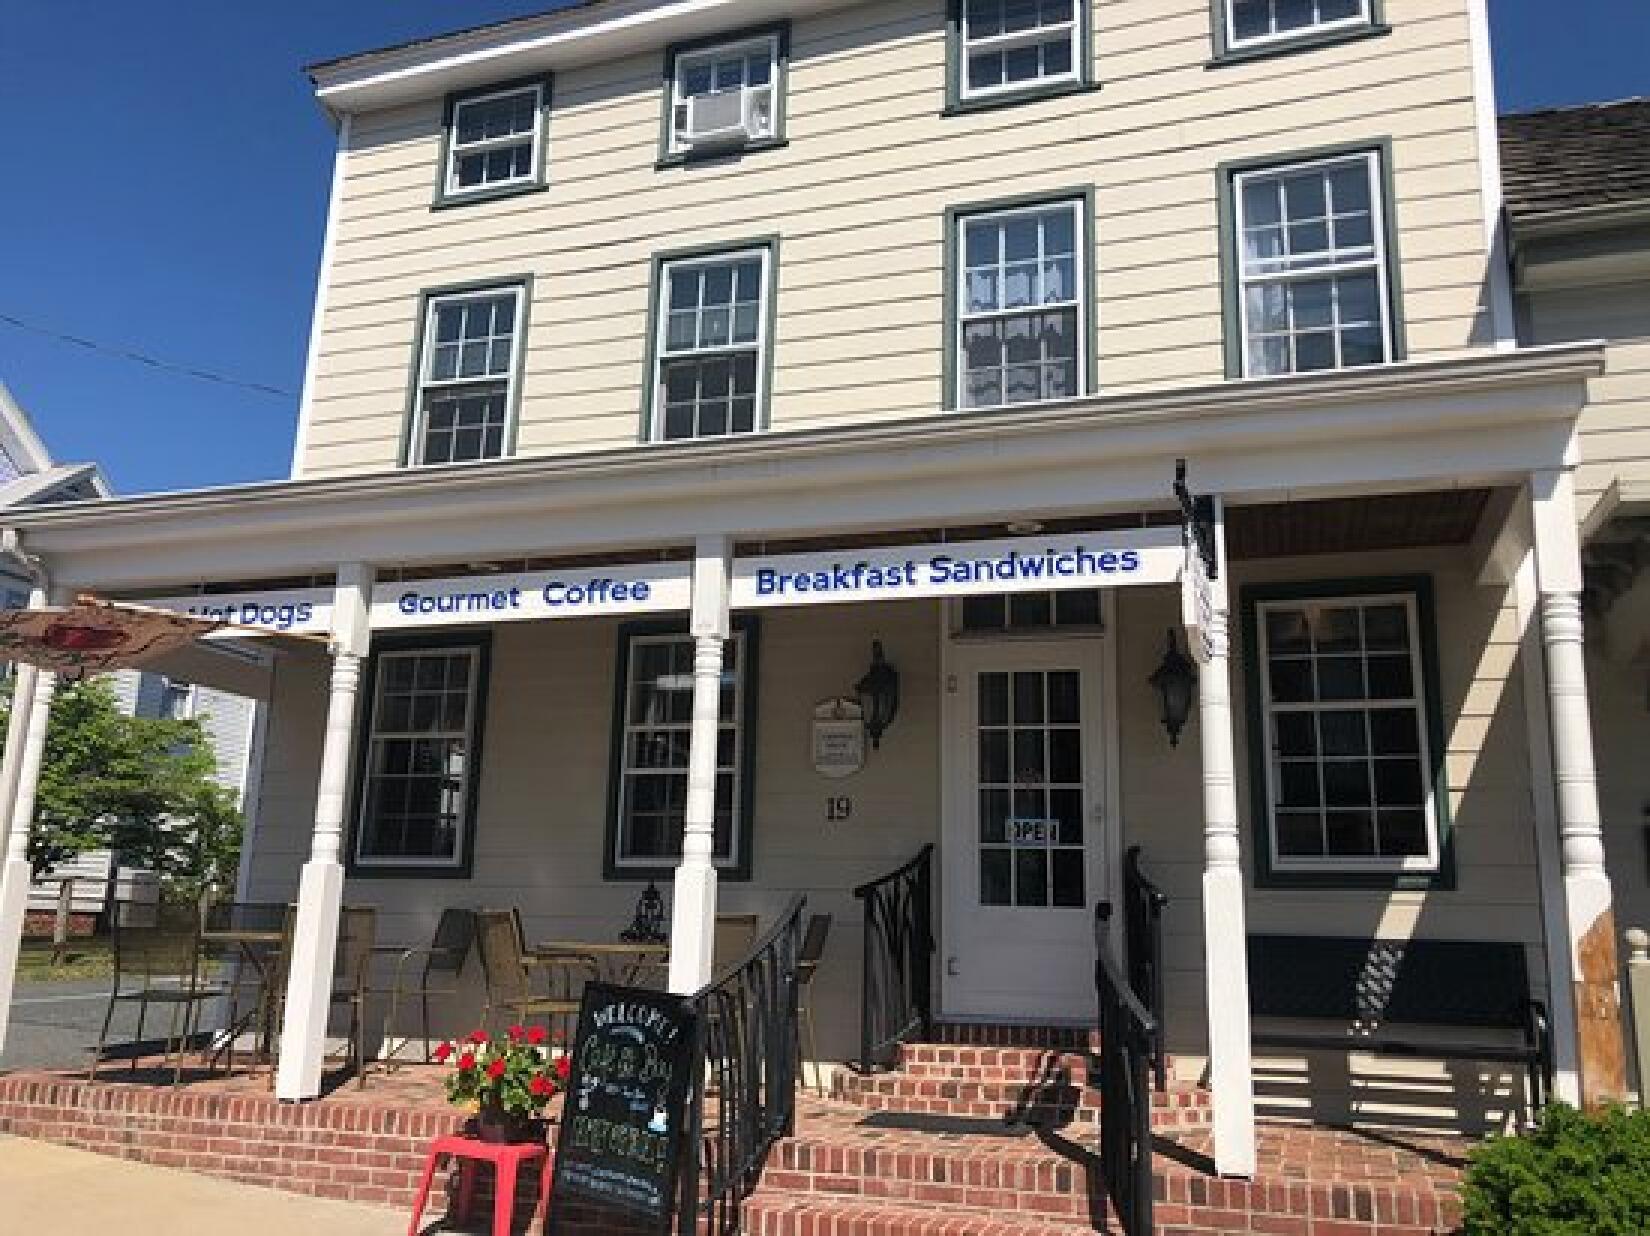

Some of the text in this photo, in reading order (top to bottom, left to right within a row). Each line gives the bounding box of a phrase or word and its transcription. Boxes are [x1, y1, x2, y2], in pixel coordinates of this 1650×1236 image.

[756, 547, 1139, 596] Breakfast Sandwiches
[399, 579, 652, 616] Gourmet Coffee
[241, 602, 313, 631] Dogs
[827, 797, 850, 820] 19
